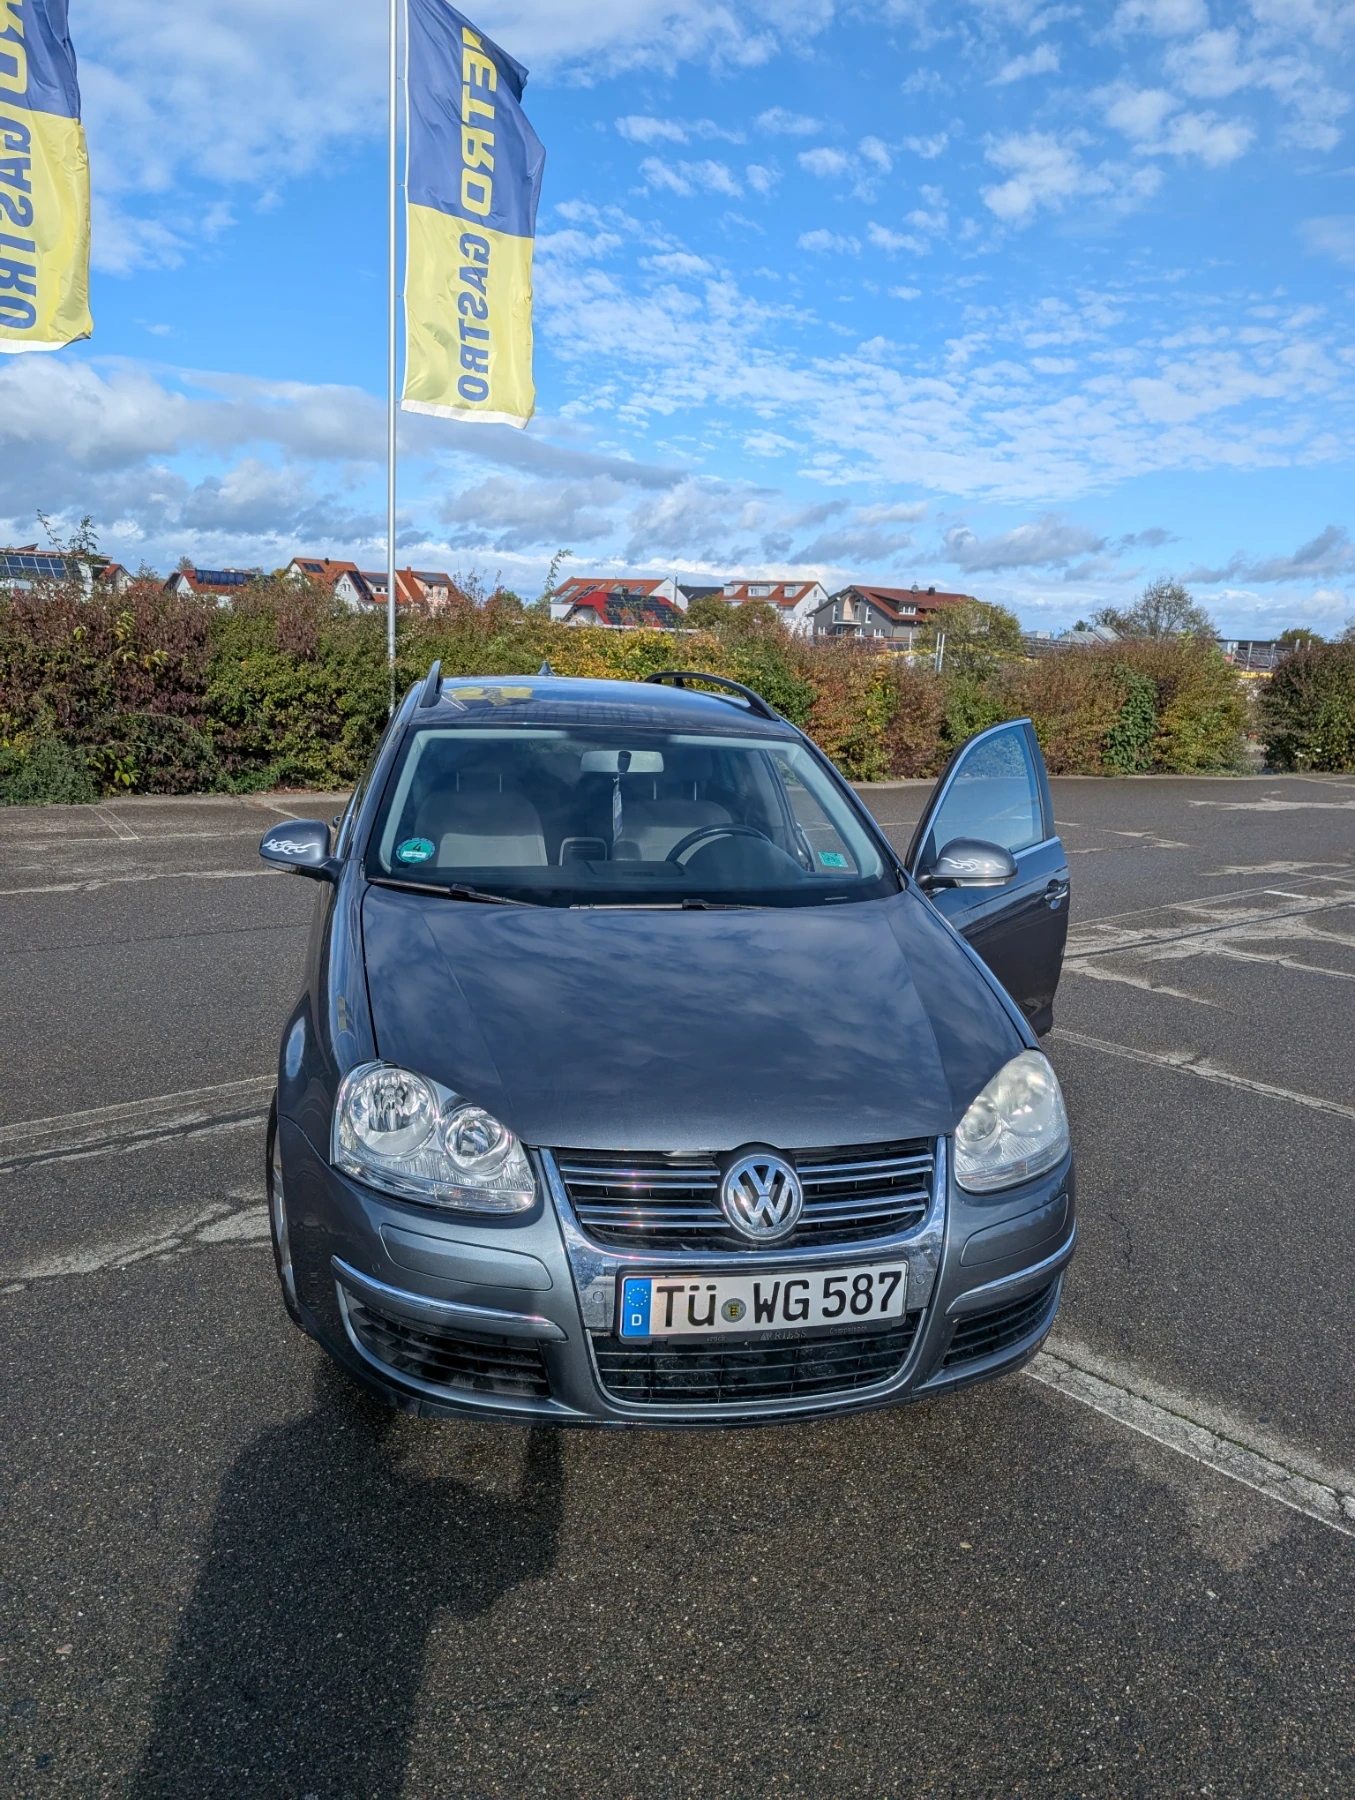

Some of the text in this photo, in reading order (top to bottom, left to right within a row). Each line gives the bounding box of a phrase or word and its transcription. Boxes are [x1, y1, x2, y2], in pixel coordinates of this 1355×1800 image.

[725, 1157, 800, 1235] VW
[631, 1313, 643, 1327] D
[656, 1271, 902, 1328] TÜ WG 587
